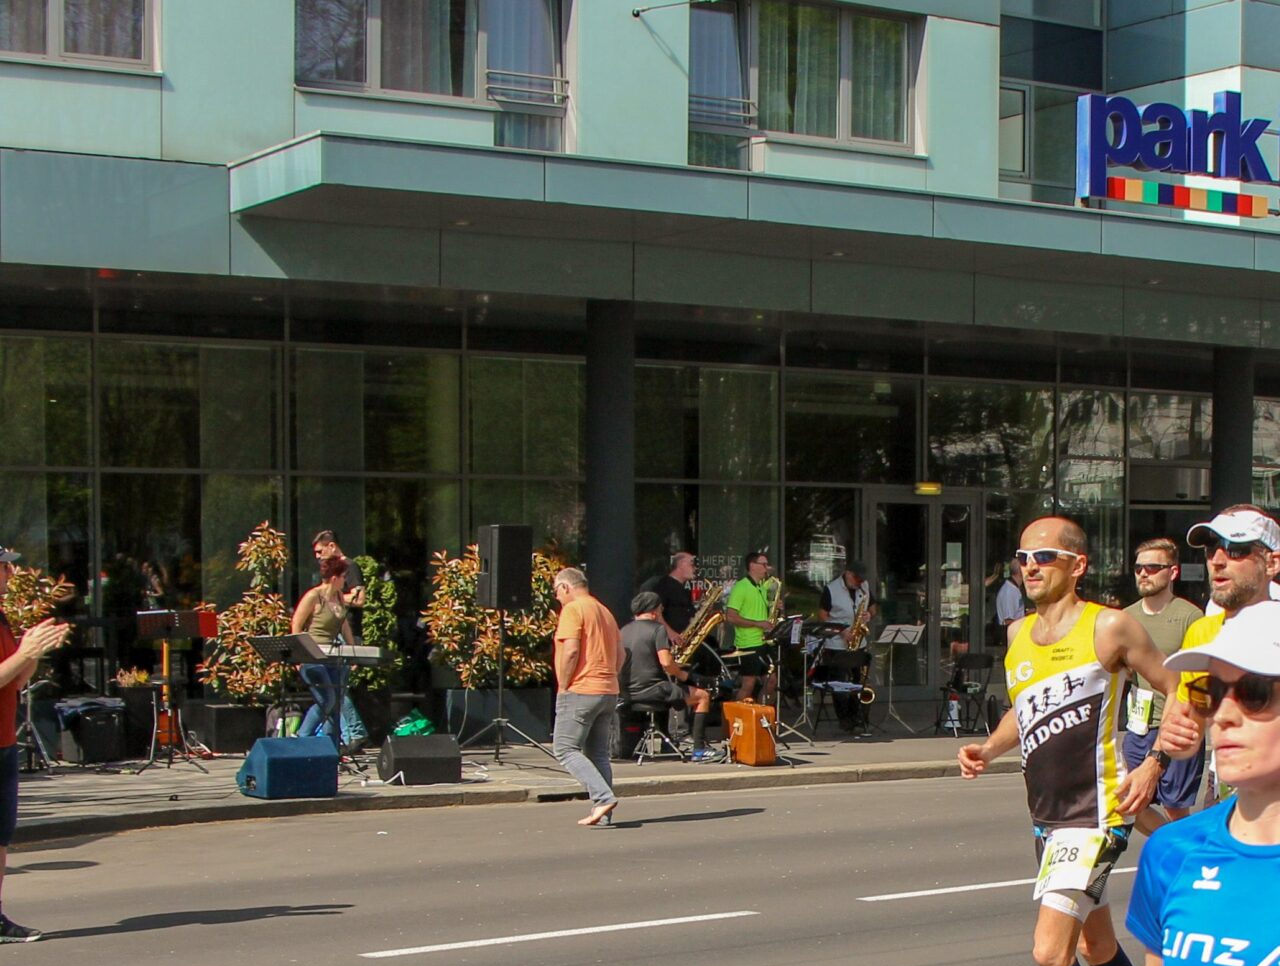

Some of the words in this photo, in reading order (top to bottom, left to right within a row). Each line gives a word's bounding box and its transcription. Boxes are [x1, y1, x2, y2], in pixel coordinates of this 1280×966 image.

[1077, 90, 1273, 199] park
[702, 555, 725, 567] HIER
[727, 555, 743, 567] IST
